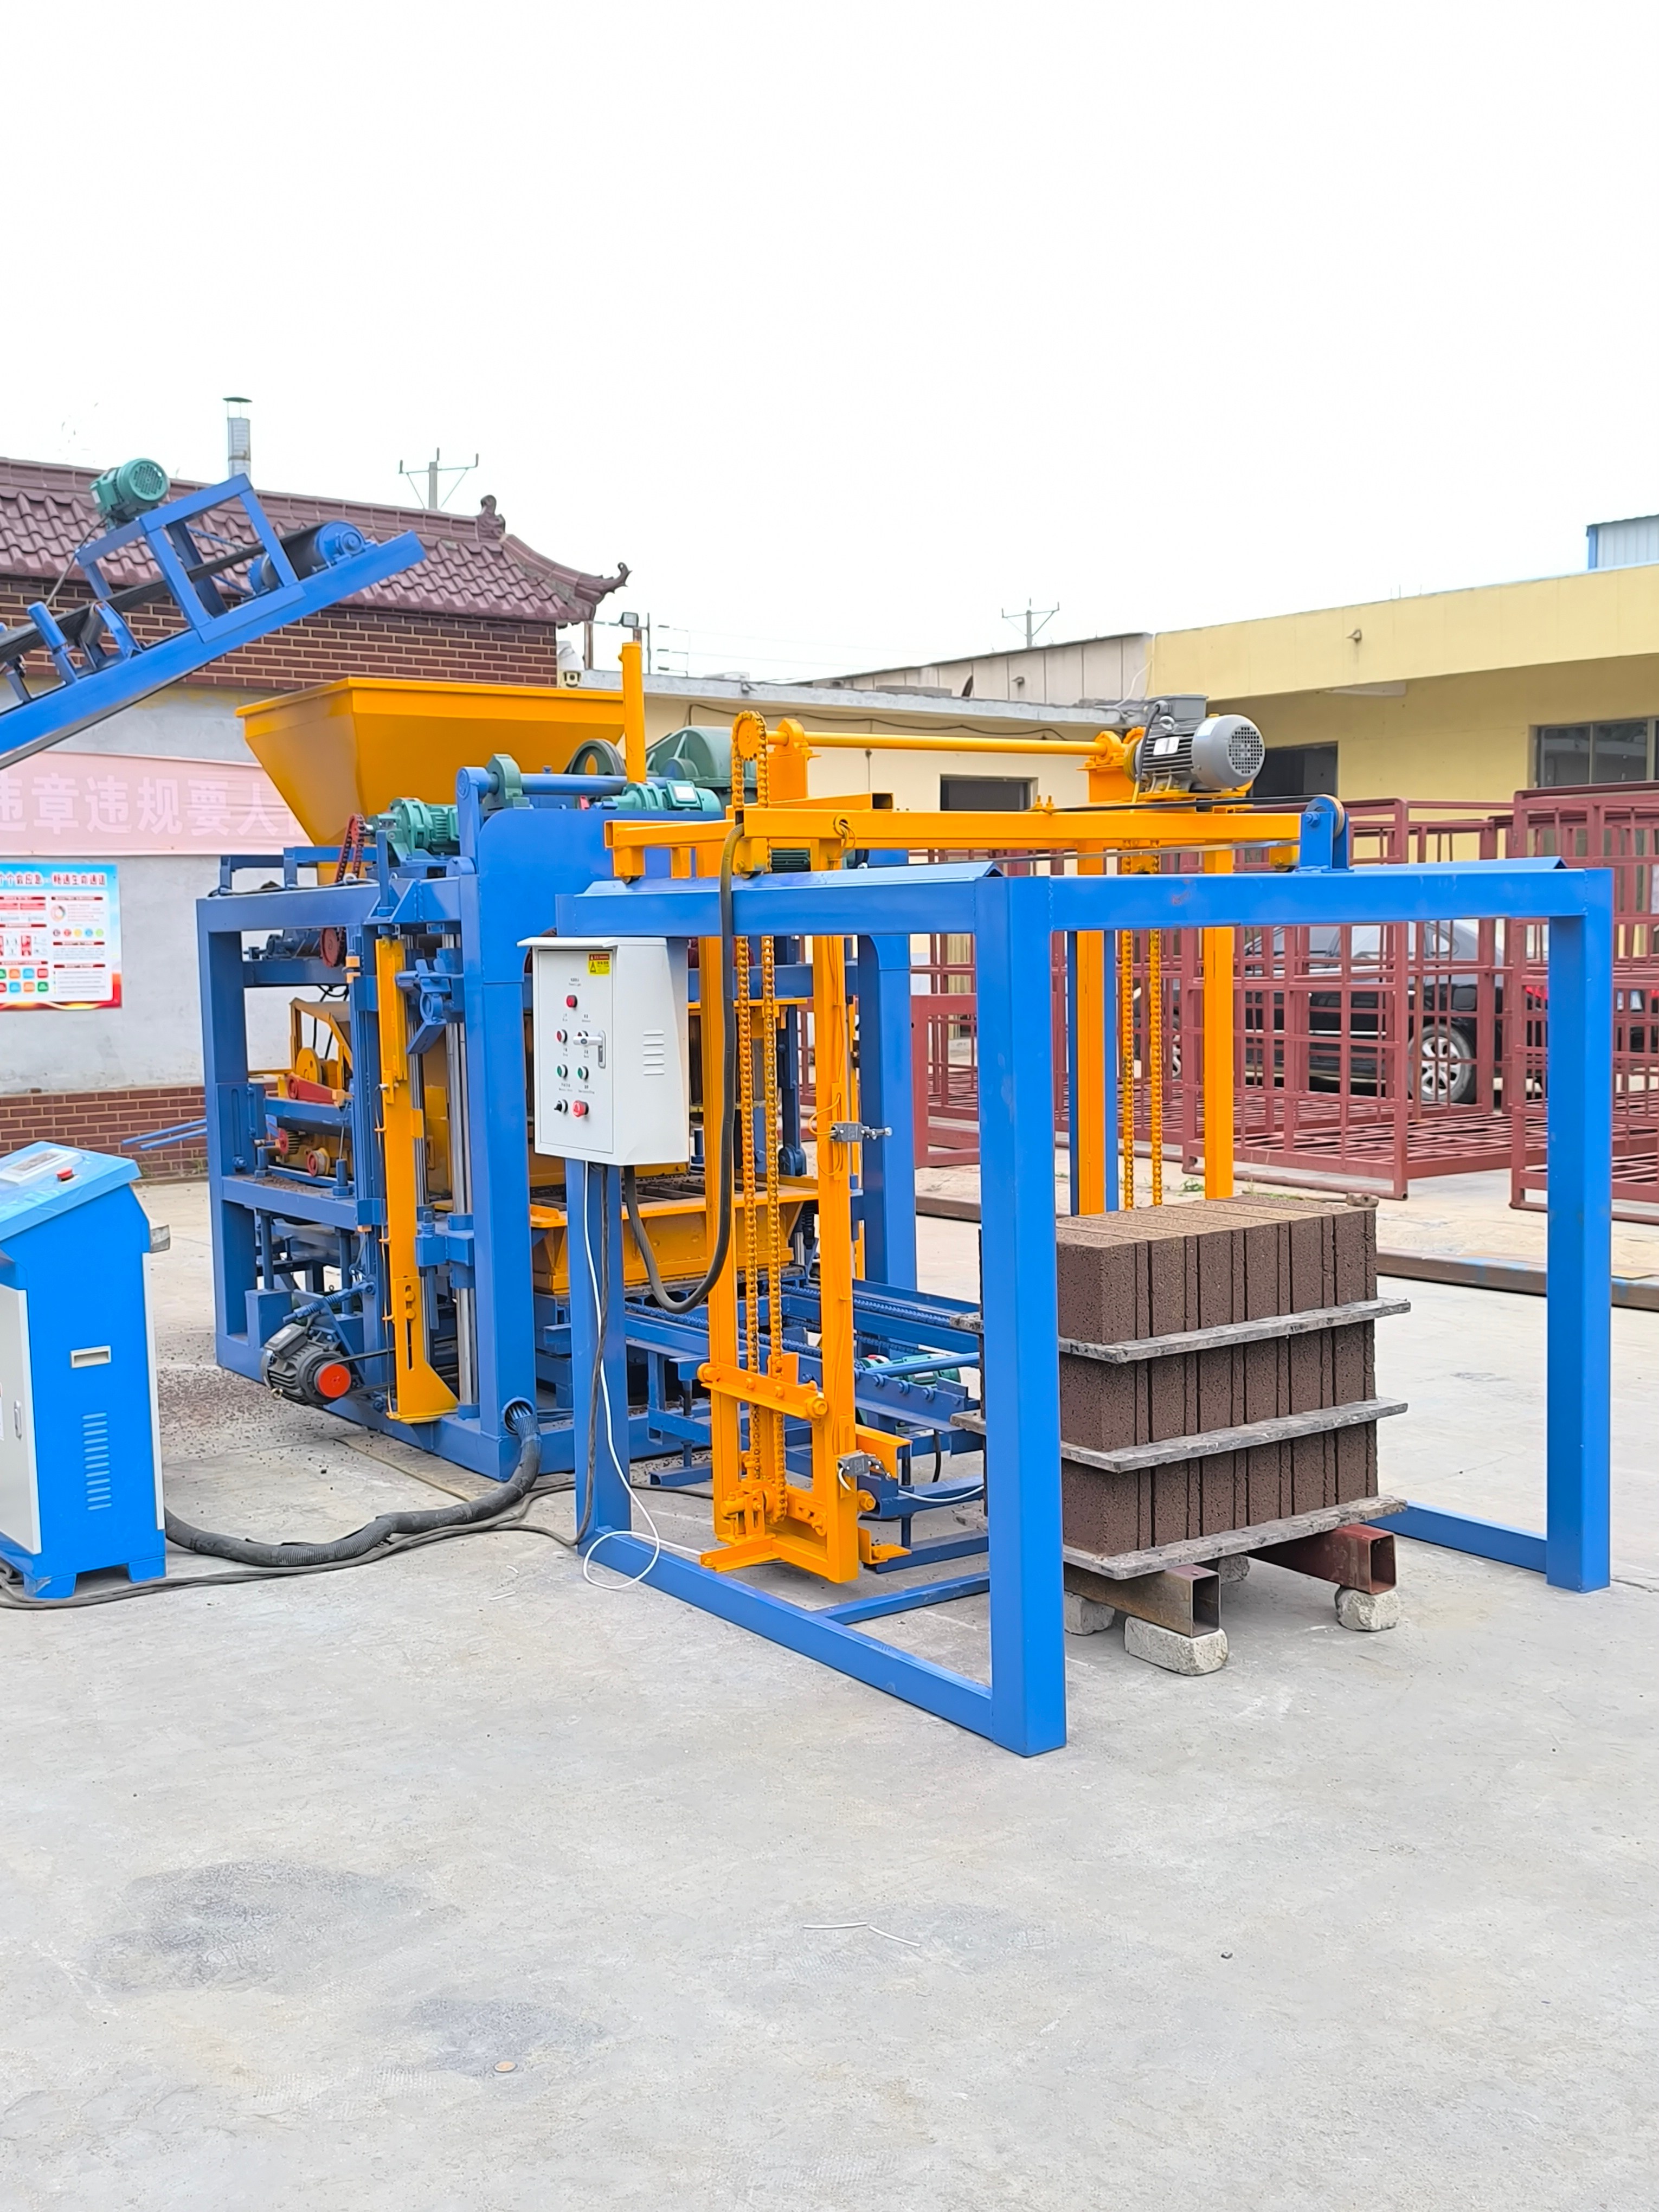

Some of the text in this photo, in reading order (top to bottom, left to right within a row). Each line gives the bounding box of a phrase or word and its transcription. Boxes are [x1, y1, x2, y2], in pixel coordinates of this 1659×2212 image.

[0, 771, 305, 836] 违章违规要人
